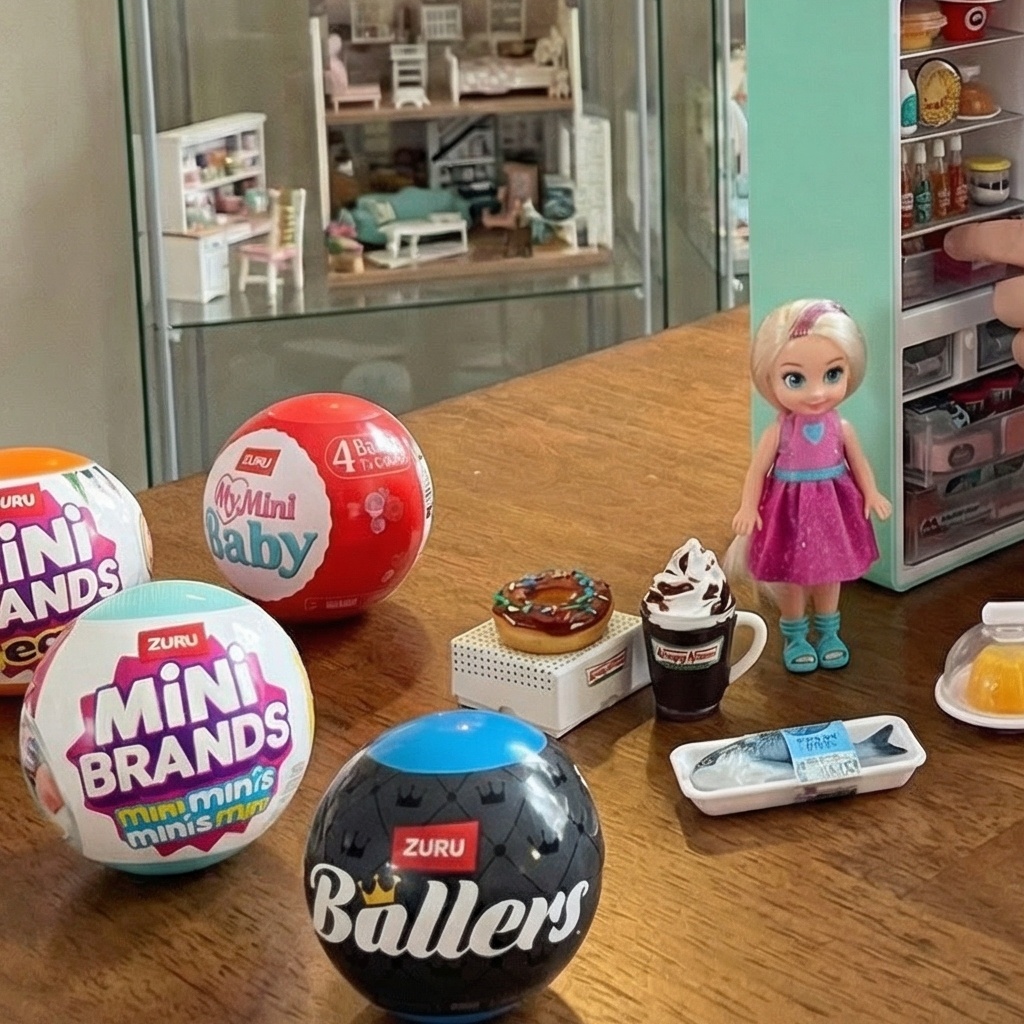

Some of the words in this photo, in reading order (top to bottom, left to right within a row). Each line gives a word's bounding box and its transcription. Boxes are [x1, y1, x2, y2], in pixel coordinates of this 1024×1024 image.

[332, 439, 356, 473] 4
[0, 492, 35, 509] URU
[215, 481, 241, 518] My
[236, 487, 296, 521] Mini
[0, 503, 93, 585] iNi
[206, 507, 318, 579] Baby
[0, 558, 119, 628] ANDS
[148, 632, 198, 651] ZURU
[78, 702, 290, 798] BRANDS
[403, 838, 465, 857] ZURU
[310, 863, 589, 959] Ballers
